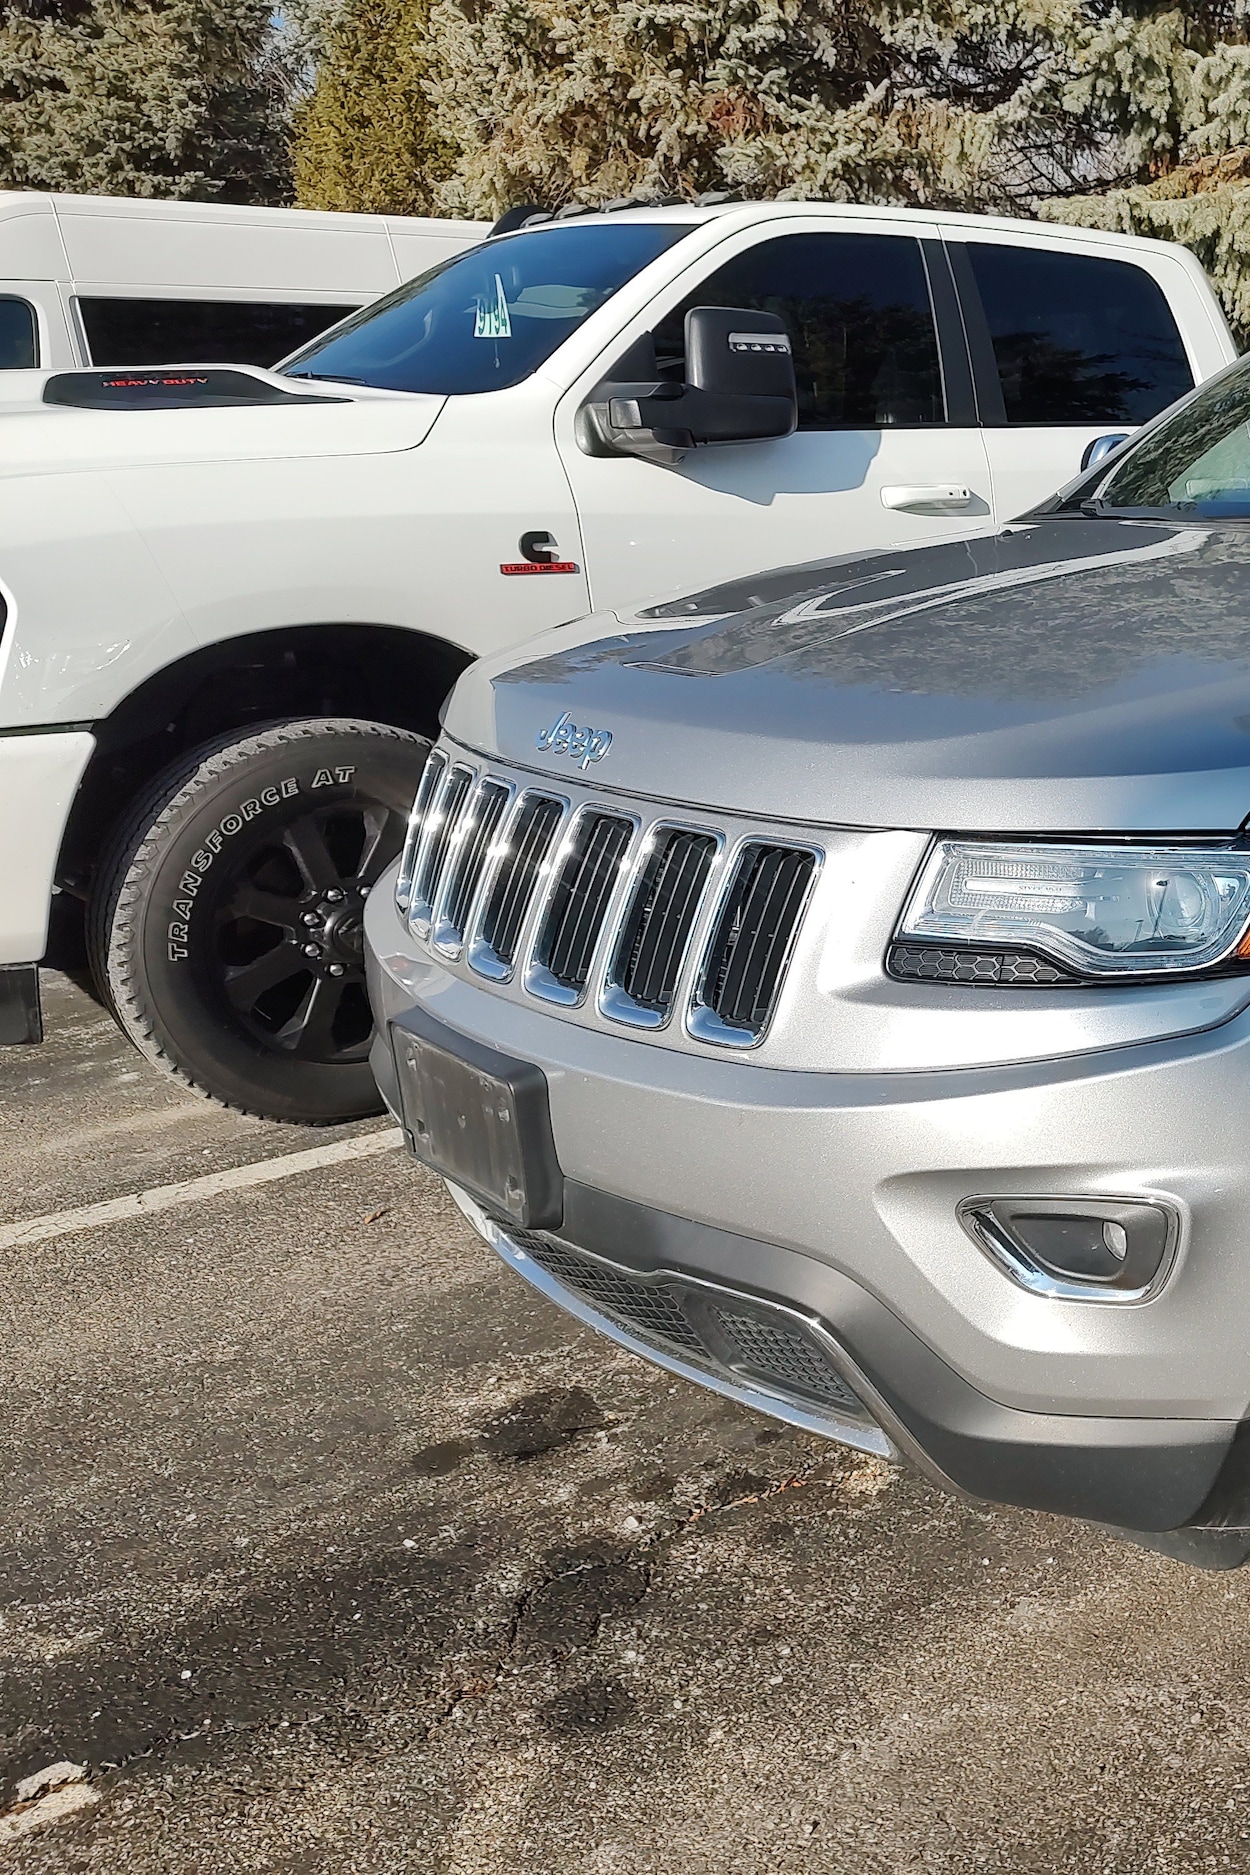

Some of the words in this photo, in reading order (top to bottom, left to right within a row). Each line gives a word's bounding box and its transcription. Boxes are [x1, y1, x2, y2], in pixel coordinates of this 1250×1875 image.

[102, 379, 160, 388] HEAVY
[162, 377, 208, 386] DUTY
[503, 564, 538, 573] TURBO
[539, 562, 576, 572] DIESEL
[536, 711, 613, 771] Jeep
[168, 777, 300, 962] TRANSFORCE
[311, 766, 356, 789] AT
